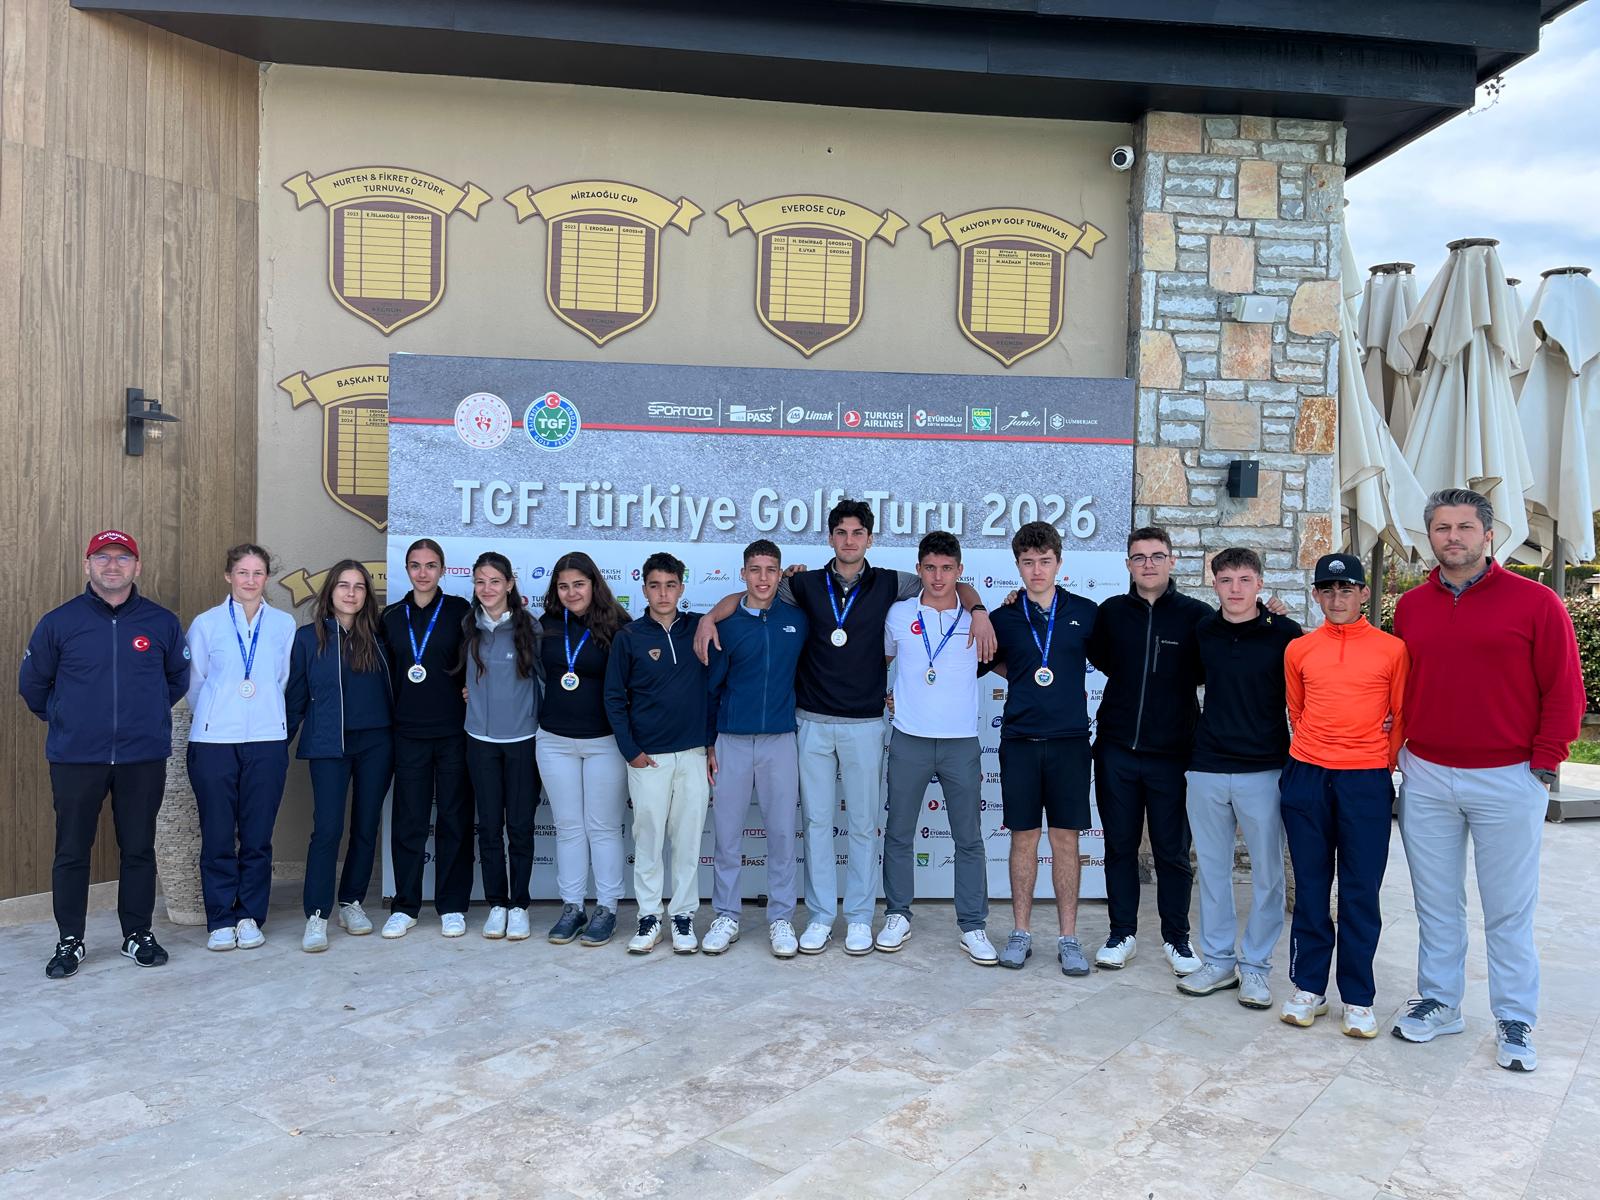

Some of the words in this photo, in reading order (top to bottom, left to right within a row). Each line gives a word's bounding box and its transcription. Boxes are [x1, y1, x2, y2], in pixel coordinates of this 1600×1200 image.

[333, 173, 368, 188] NURTEN
[370, 173, 377, 181] &
[379, 172, 409, 183] FİKRET
[411, 176, 446, 196] ÖZTÜRK
[364, 184, 415, 195] TURNUVASI
[571, 190, 619, 201] MİRZAOĞLU
[621, 194, 638, 204] CUP
[781, 204, 824, 214] EVEROSE
[827, 206, 846, 217] CUP
[960, 219, 990, 234] KALYON
[1027, 220, 1068, 241] TURNUVASI
[336, 375, 374, 388] BAŞKAN
[648, 405, 713, 417] SPORTOTO
[805, 410, 834, 421] Limak
[865, 411, 904, 420] TURKISH
[538, 418, 567, 429] TGF
[747, 413, 773, 423] PASS
[864, 419, 904, 428] AIRLINES
[927, 414, 963, 423] EYÜBOĞLU
[1001, 415, 1041, 431] Jumbo
[534, 435, 550, 446] GOLF
[453, 479, 544, 526] TGF
[559, 481, 736, 541] Türkiye
[862, 490, 964, 535] Turu
[981, 493, 1097, 539] 2026
[447, 567, 471, 575] TOTO
[982, 746, 1000, 754] Lima
[930, 828, 952, 836] EYÜBOĞL
[985, 828, 1011, 840] Jumb
[1080, 829, 1105, 837] ORTOT
[747, 859, 766, 867] PASS
[1091, 859, 1105, 867] PAS
